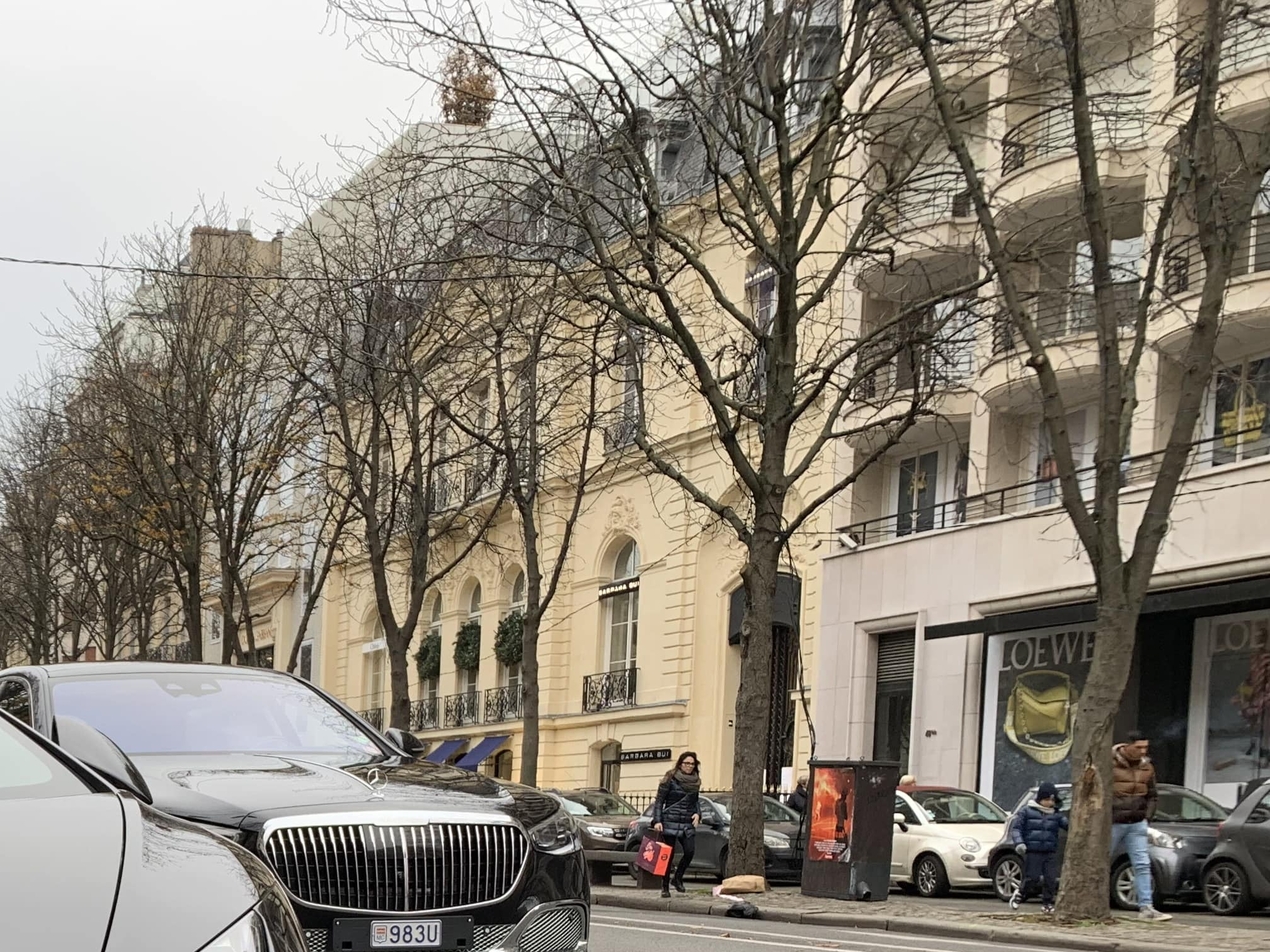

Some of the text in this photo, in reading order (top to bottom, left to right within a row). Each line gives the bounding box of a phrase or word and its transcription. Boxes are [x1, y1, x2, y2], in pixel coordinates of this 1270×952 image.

[1211, 620, 1270, 654] LOE
[999, 630, 1095, 672] LOEWE
[620, 752, 654, 761] BARBARA
[389, 924, 438, 944] 983U
